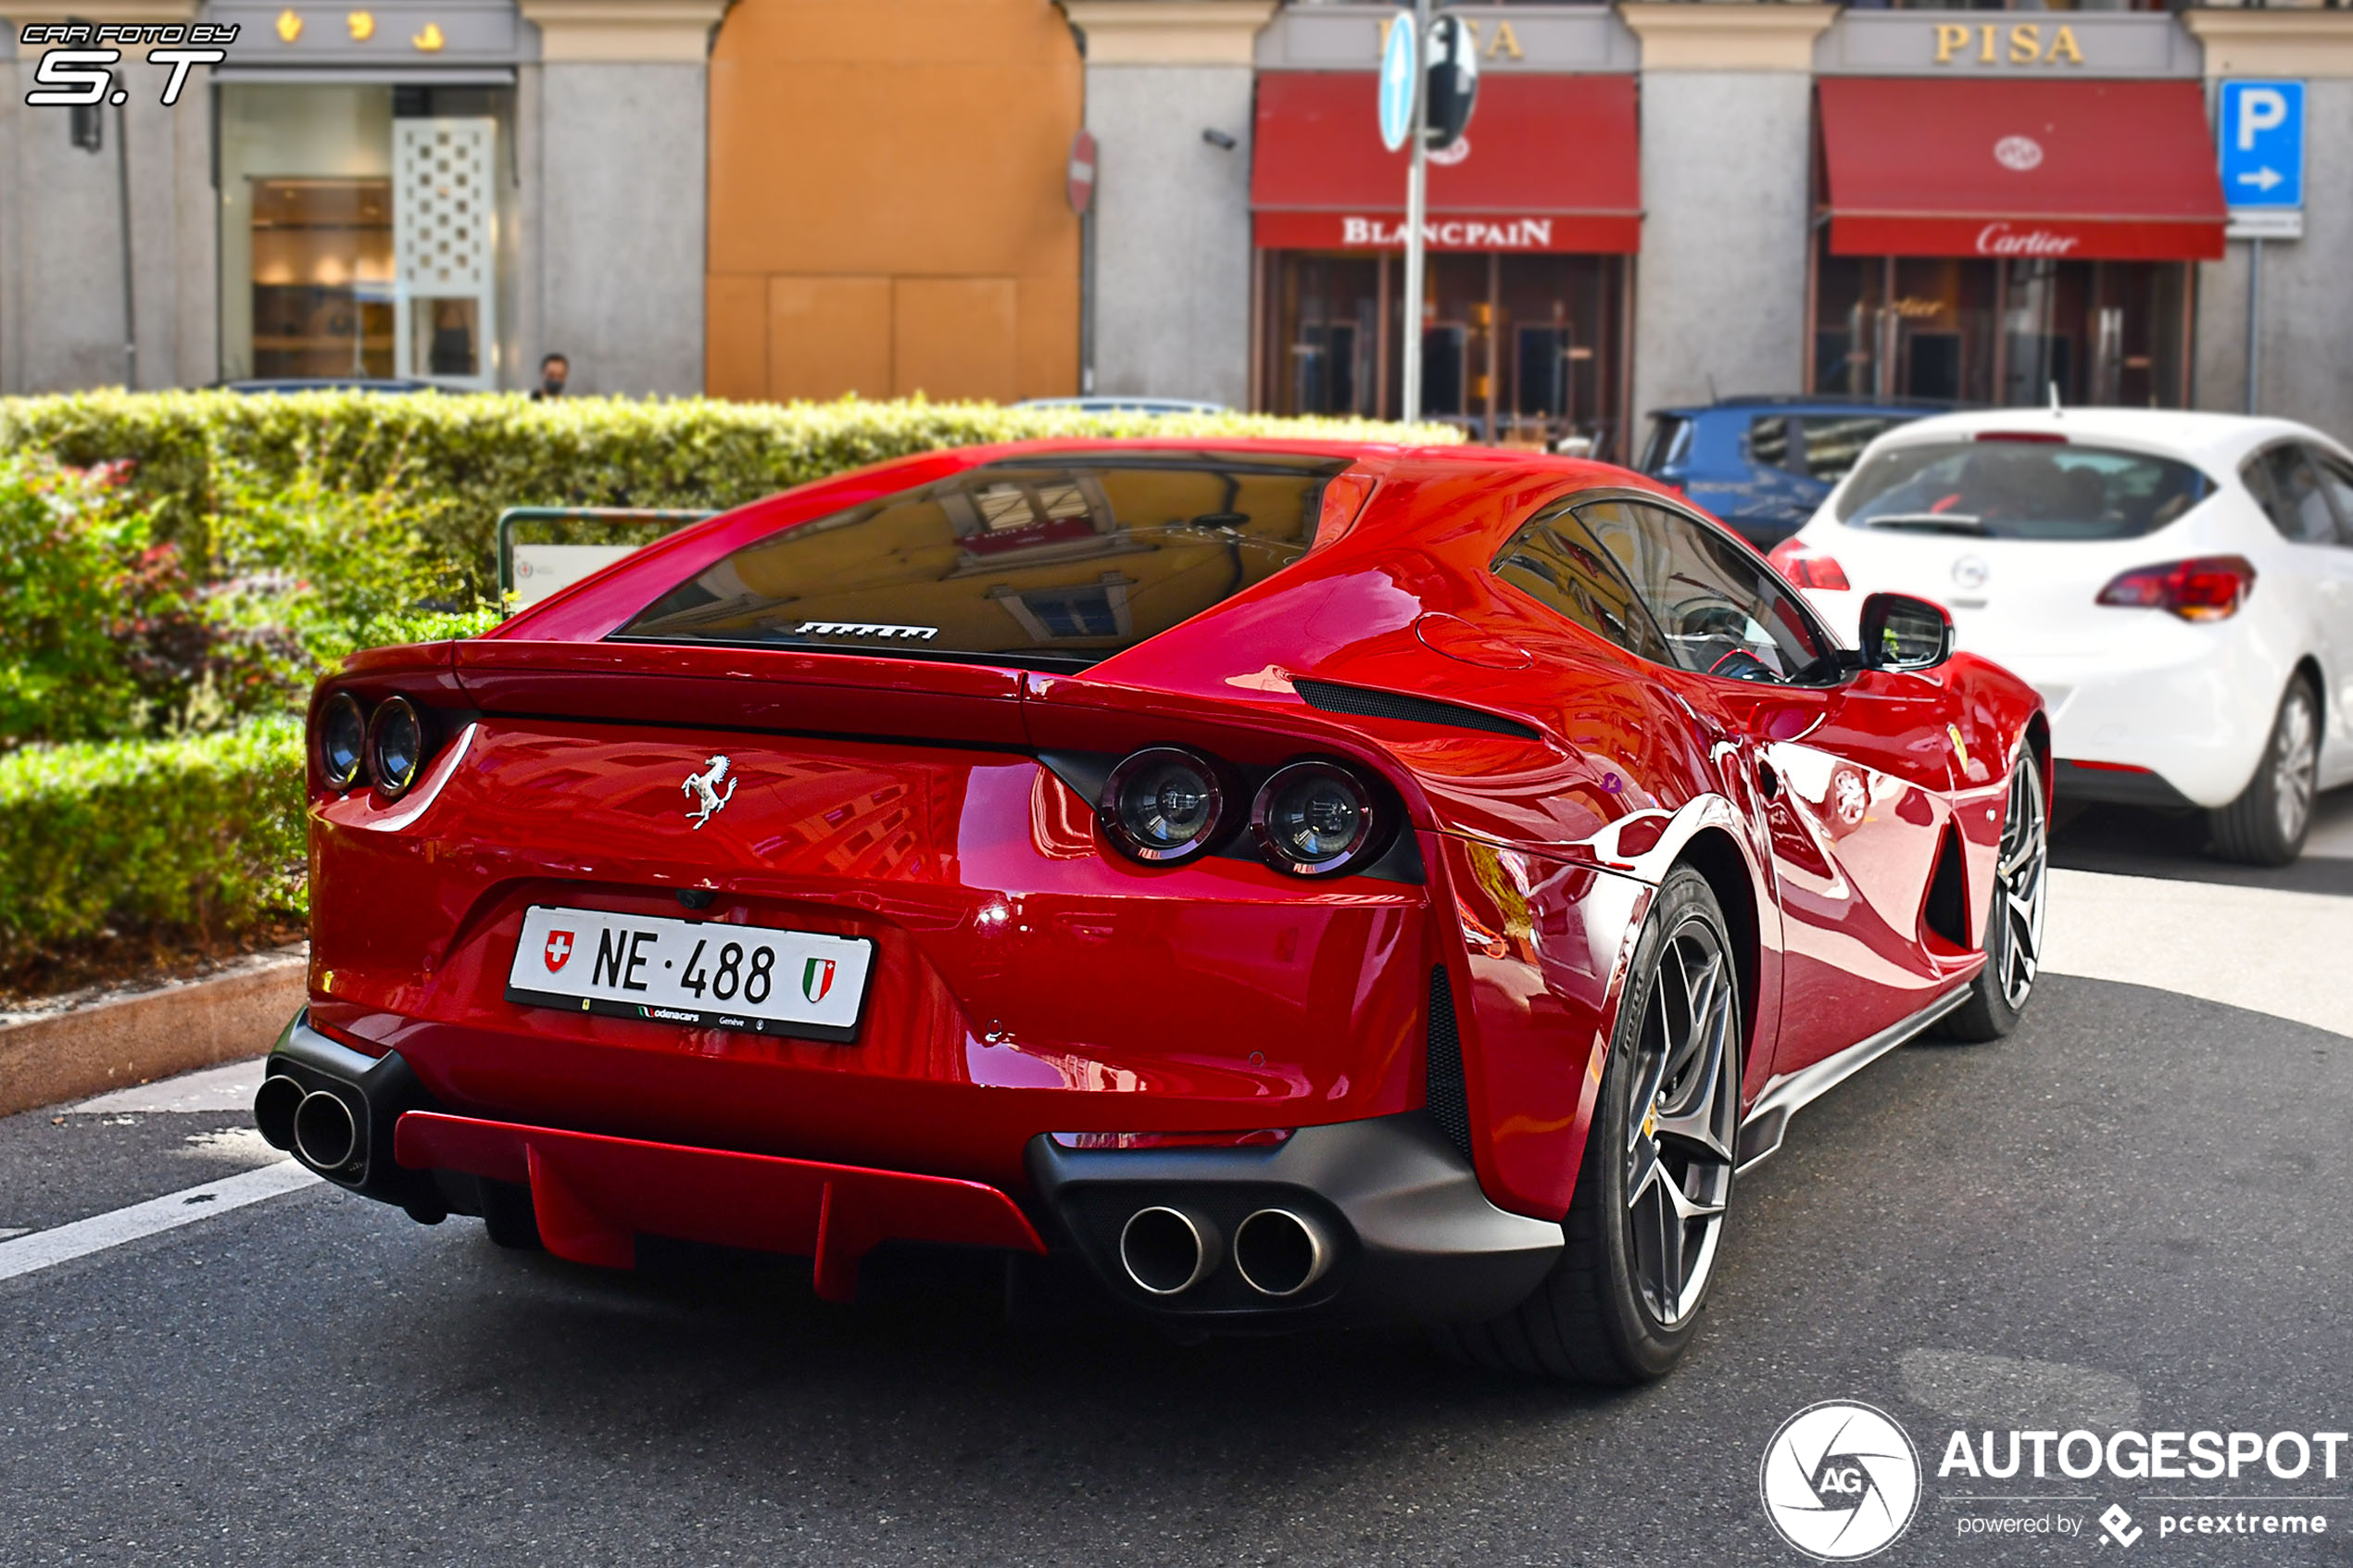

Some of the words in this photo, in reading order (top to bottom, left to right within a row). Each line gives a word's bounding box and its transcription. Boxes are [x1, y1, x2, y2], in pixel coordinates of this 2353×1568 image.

[1935, 24, 2084, 63] PISA
[2237, 88, 2287, 151] P
[1976, 223, 2078, 255] Cartier
